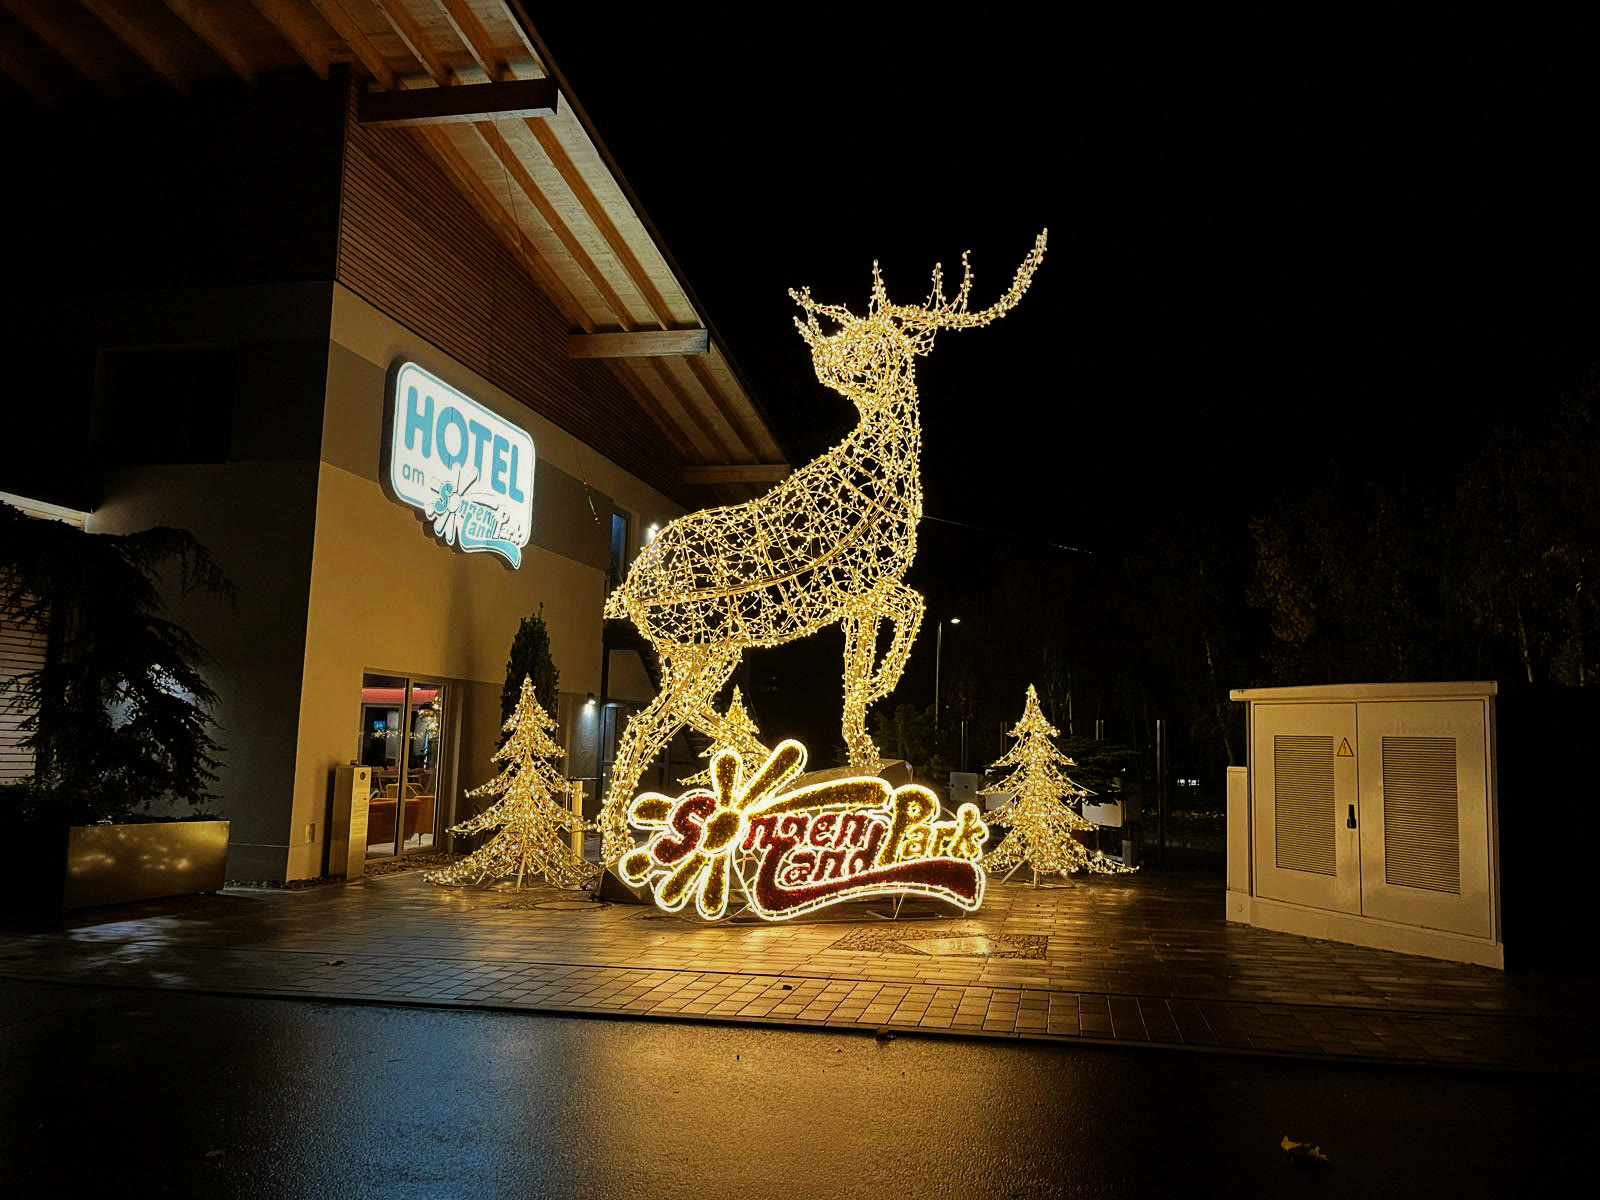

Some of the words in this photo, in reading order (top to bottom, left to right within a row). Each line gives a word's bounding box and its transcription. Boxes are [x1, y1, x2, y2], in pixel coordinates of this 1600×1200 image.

[402, 463, 425, 487] am
[404, 386, 525, 504] HOTEL
[876, 785, 989, 867] Park
